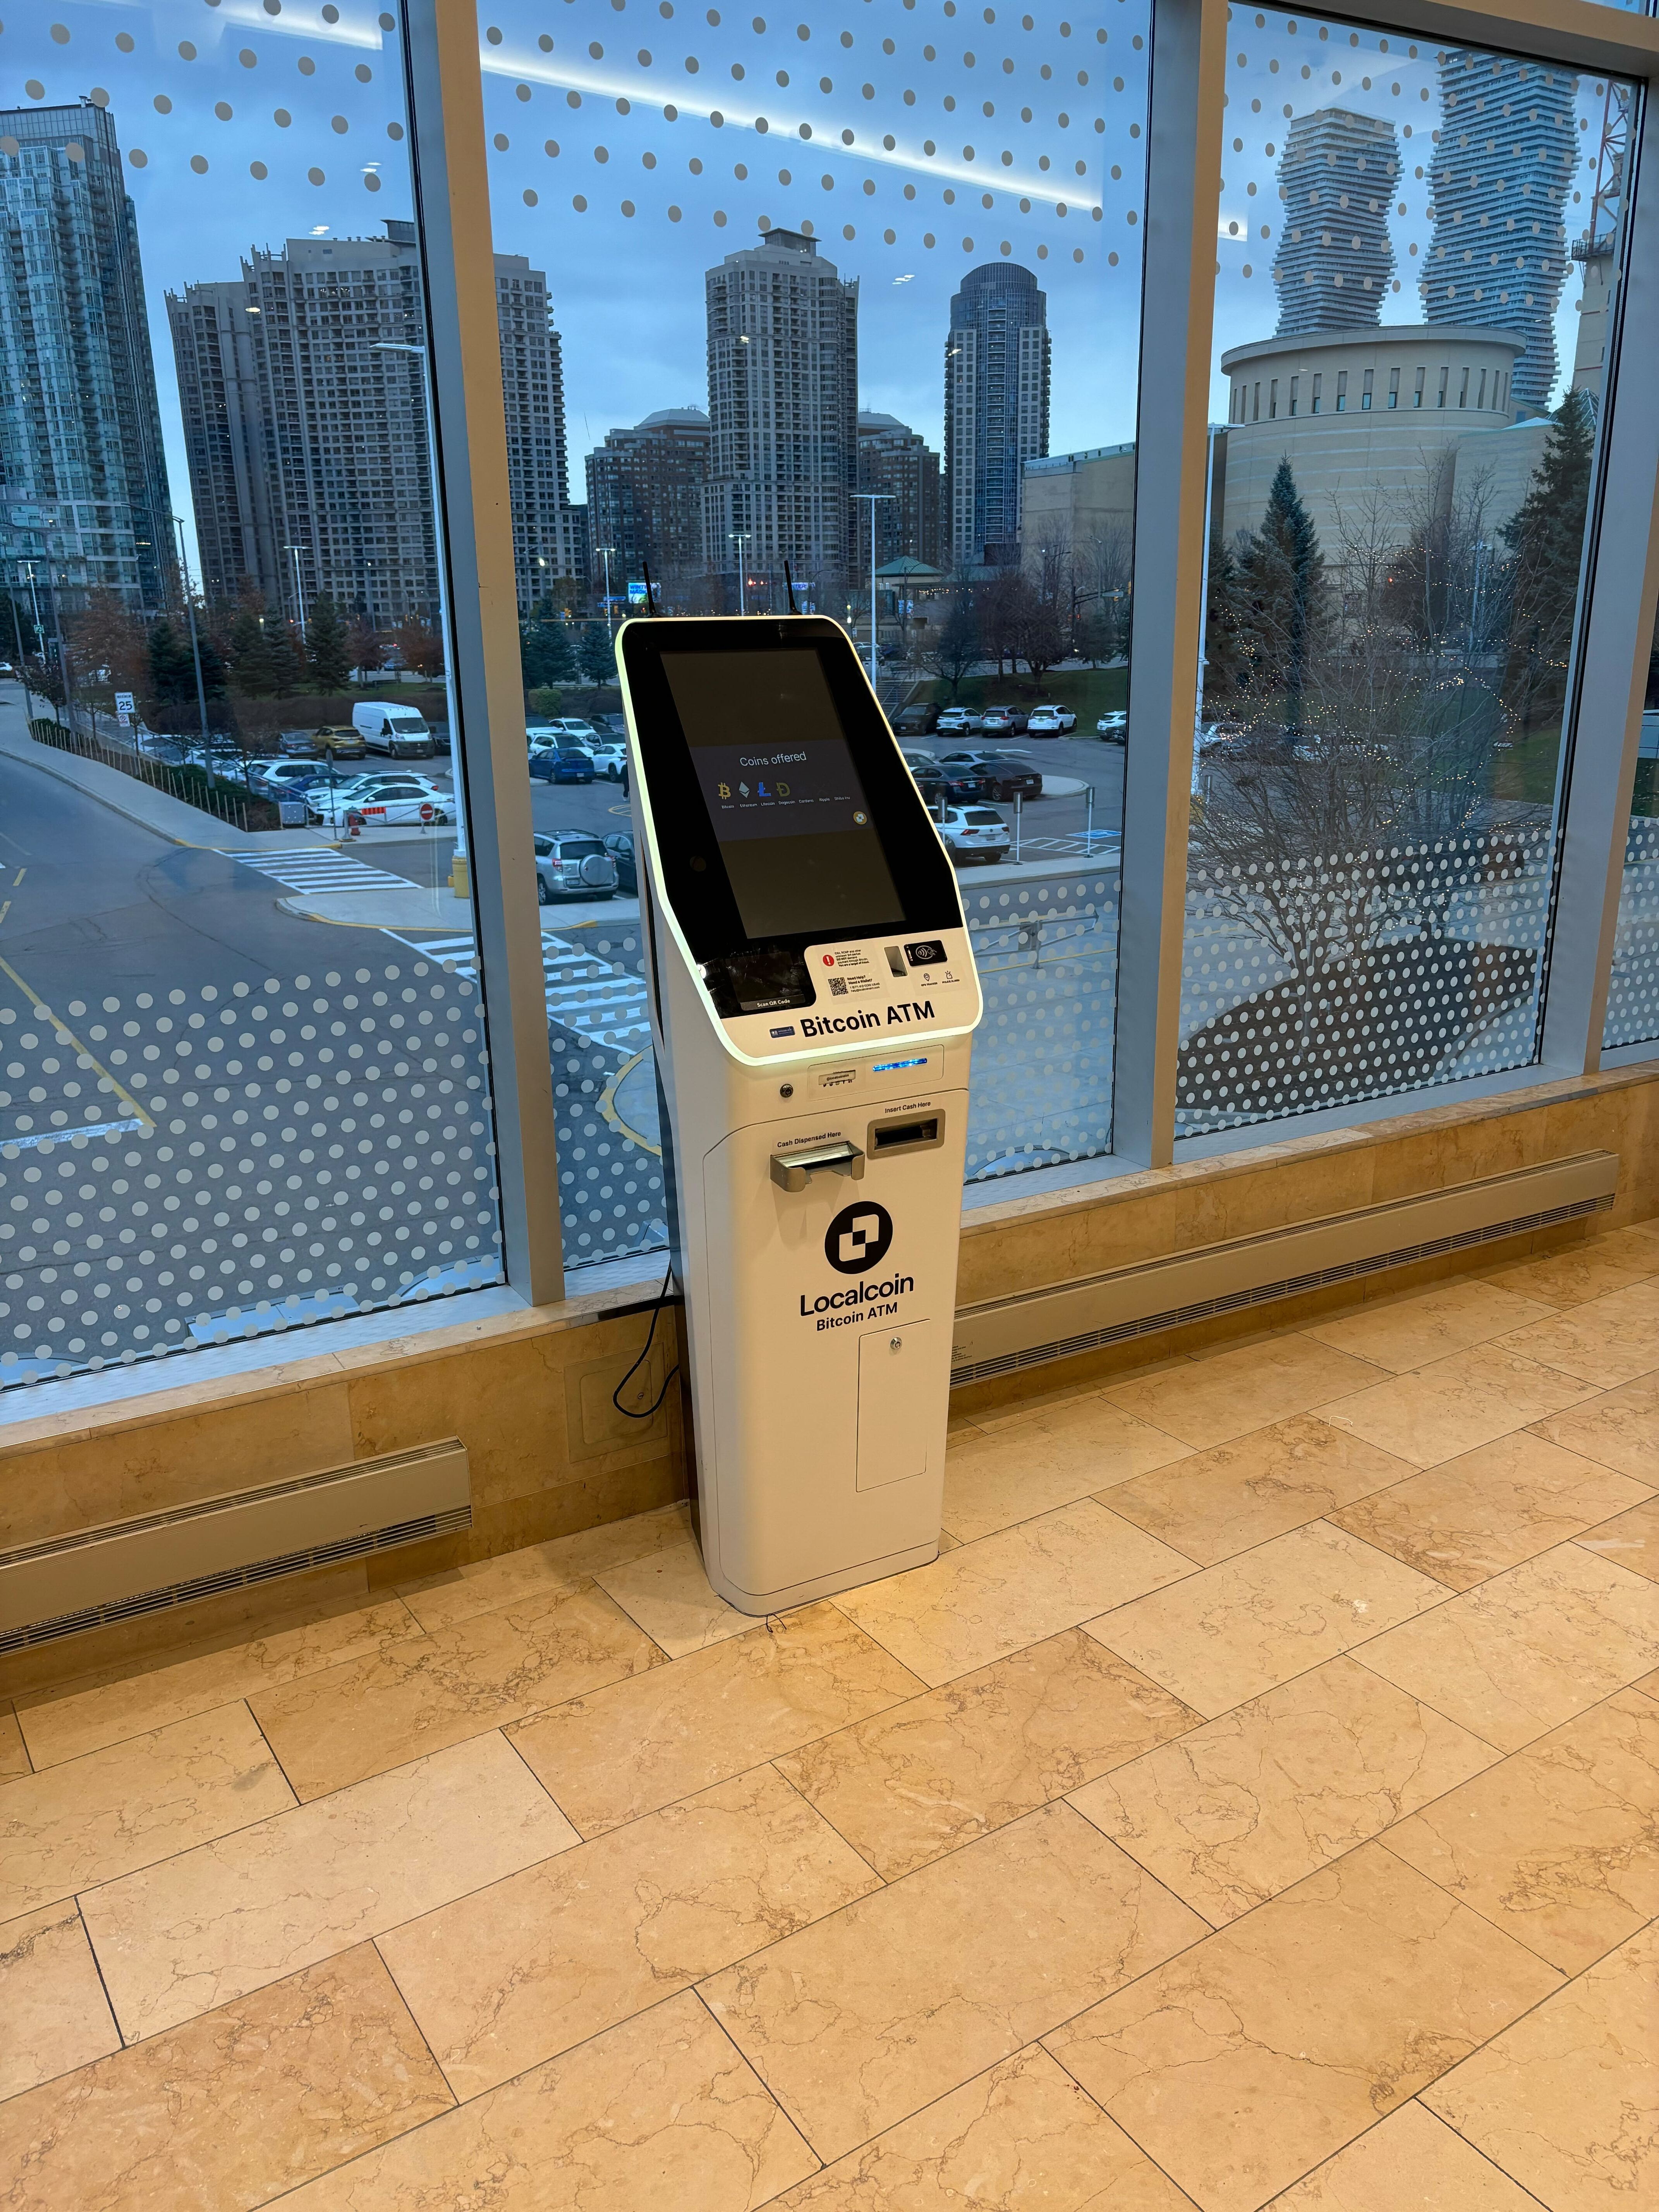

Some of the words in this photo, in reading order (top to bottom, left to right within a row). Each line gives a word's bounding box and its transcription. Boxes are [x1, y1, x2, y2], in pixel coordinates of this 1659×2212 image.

[118, 701, 132, 710] 25
[740, 757, 769, 766] Coins
[771, 751, 807, 764] offered
[800, 1010, 881, 1037] Bitcoin
[888, 1001, 935, 1024] ATM
[794, 1133, 826, 1144] Dispensed
[800, 1273, 914, 1317] Localcoin
[817, 1311, 863, 1331] Bitcoin
[867, 1302, 897, 1319] ATM
